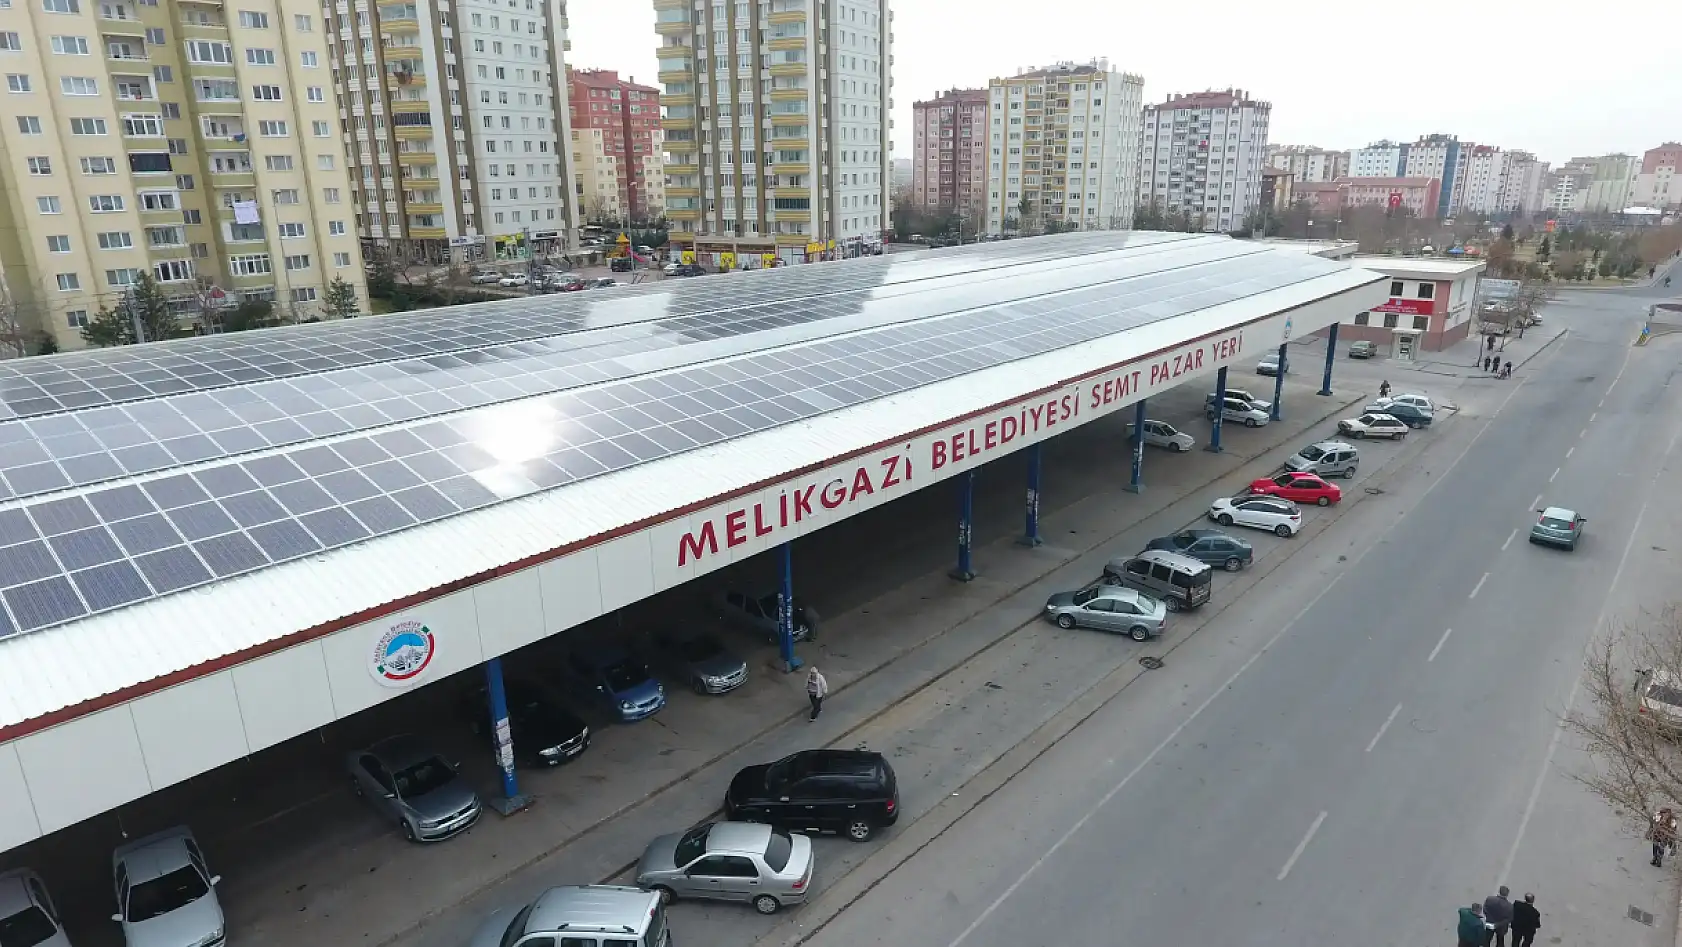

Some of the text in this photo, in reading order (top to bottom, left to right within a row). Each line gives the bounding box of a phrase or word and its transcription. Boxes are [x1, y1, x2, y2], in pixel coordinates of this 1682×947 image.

[678, 331, 1243, 566] MELİKGAZİ BELEDİYESİ SEMT PAZAR YERİ
